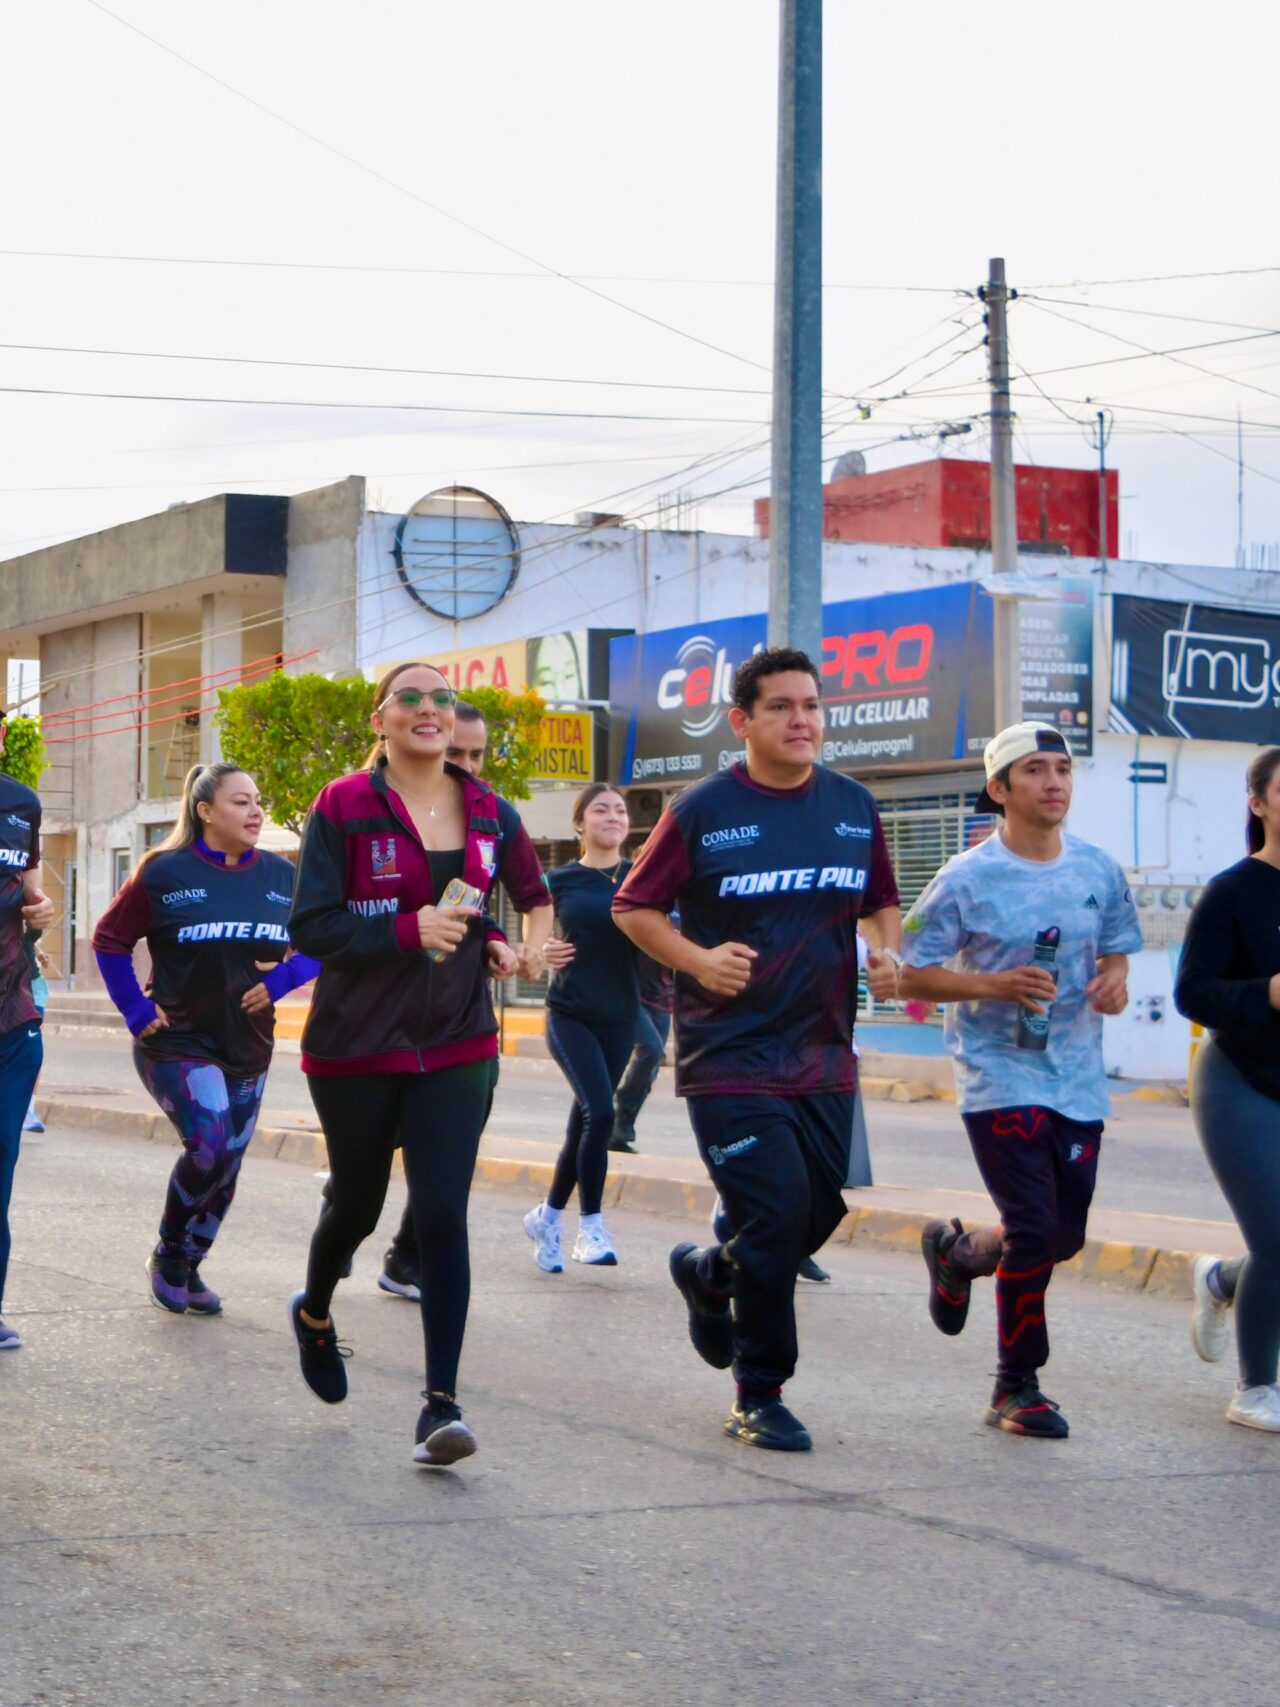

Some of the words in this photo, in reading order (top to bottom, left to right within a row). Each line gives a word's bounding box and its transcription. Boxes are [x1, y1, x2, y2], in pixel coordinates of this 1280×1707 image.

[822, 624, 934, 690] PRO
[830, 706, 851, 728] TU
[854, 697, 929, 725] CELULAR
[532, 747, 589, 775] RISTAL
[701, 825, 760, 847] CONADE
[719, 868, 816, 897] PONTE
[816, 866, 867, 890] PILA
[162, 888, 208, 905] CONADE
[178, 922, 253, 944] PONTE
